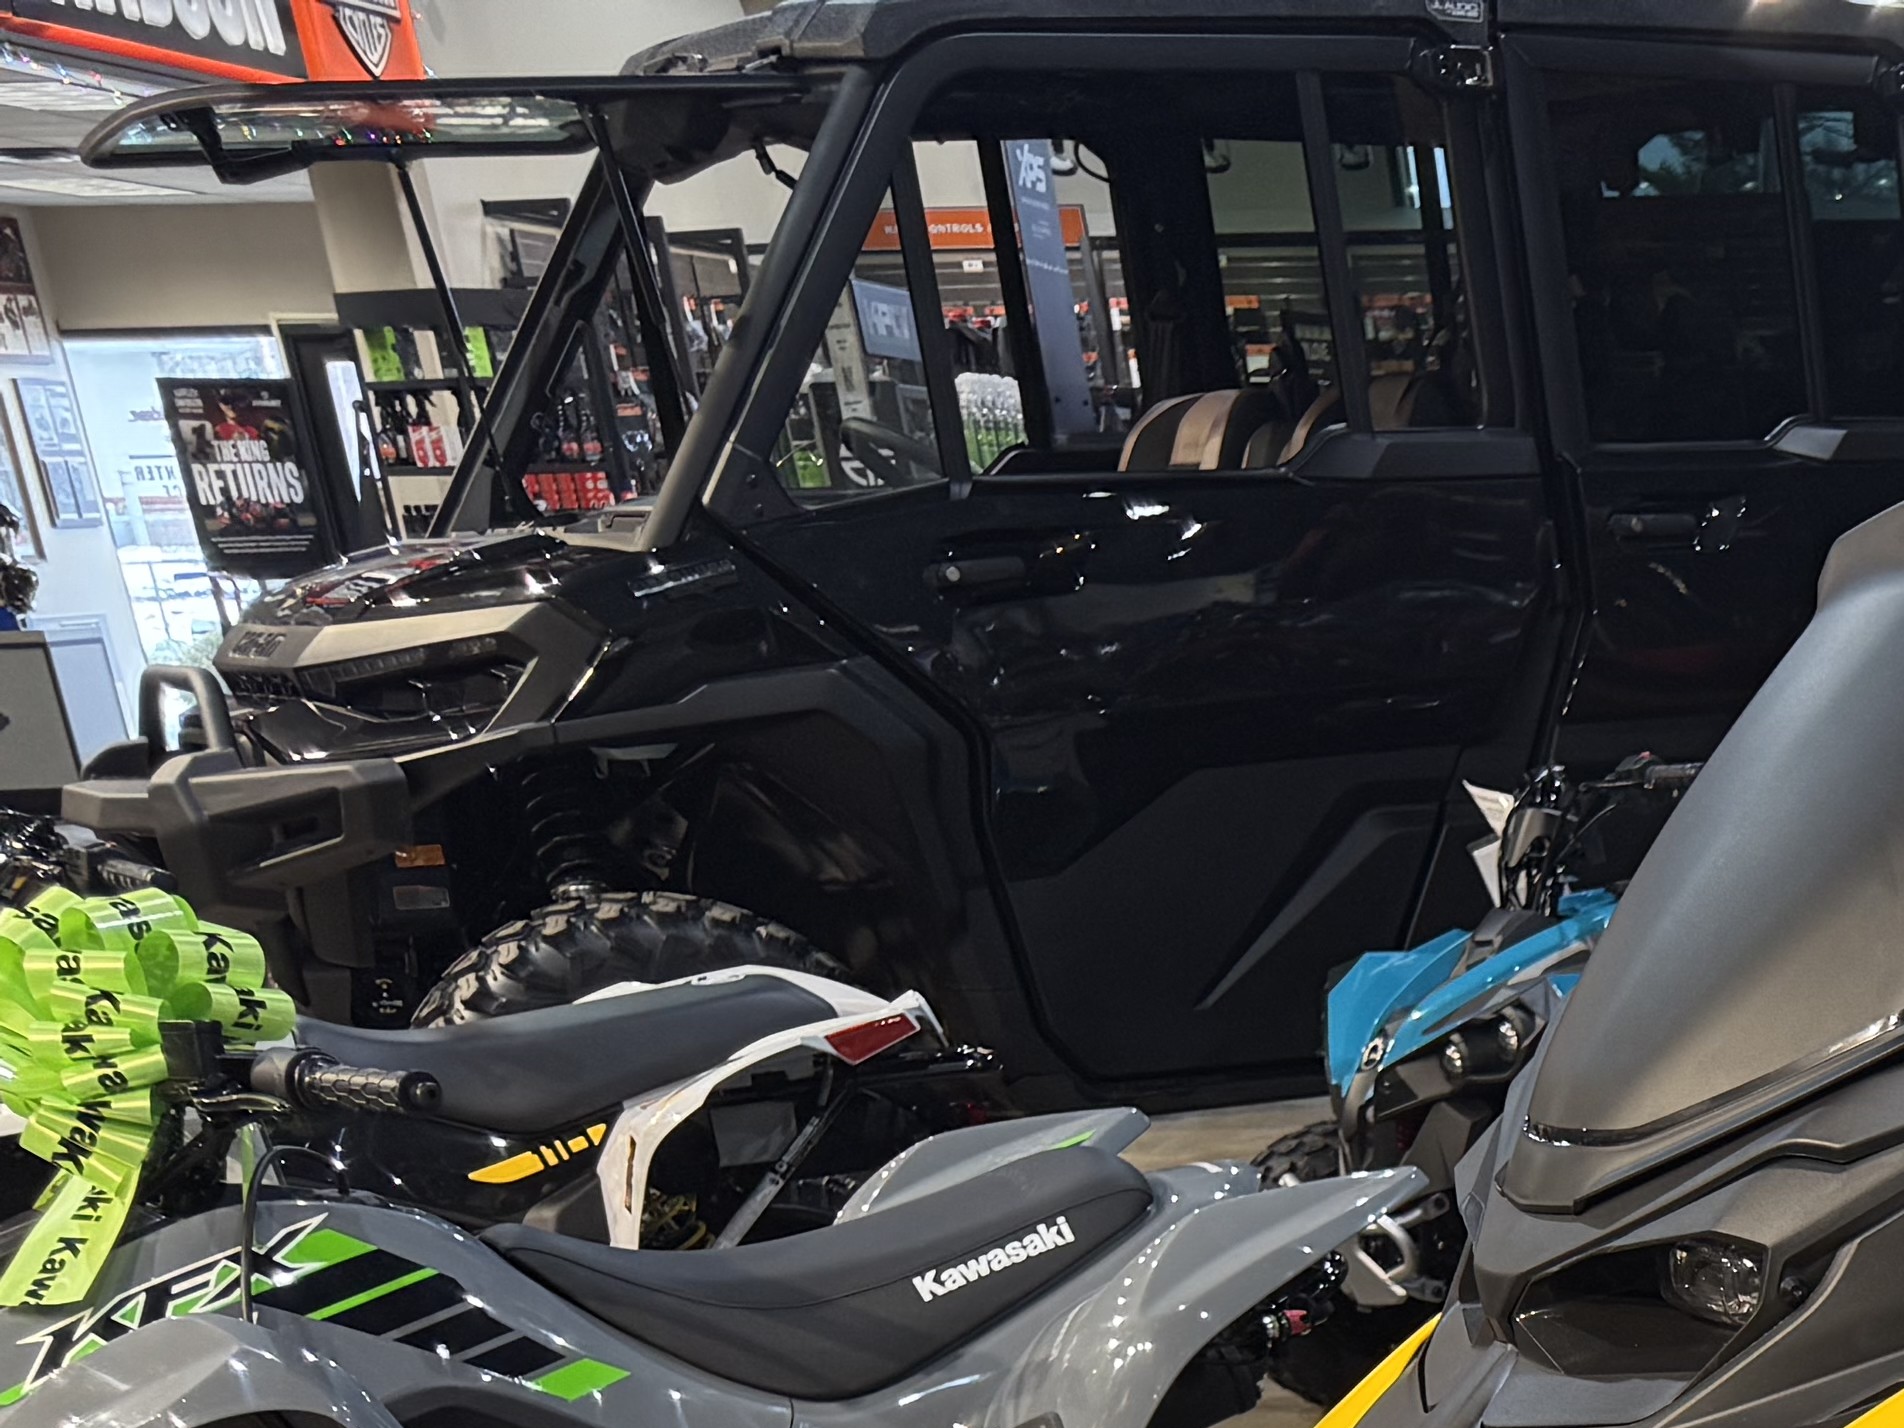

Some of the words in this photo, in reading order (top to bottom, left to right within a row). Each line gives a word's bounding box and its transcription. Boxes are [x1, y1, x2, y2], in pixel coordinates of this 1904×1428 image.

[928, 223, 984, 235] ONTROLS
[211, 440, 239, 463] THE
[191, 461, 304, 506] RETURNS
[911, 1215, 1076, 1303] Kawasaki
